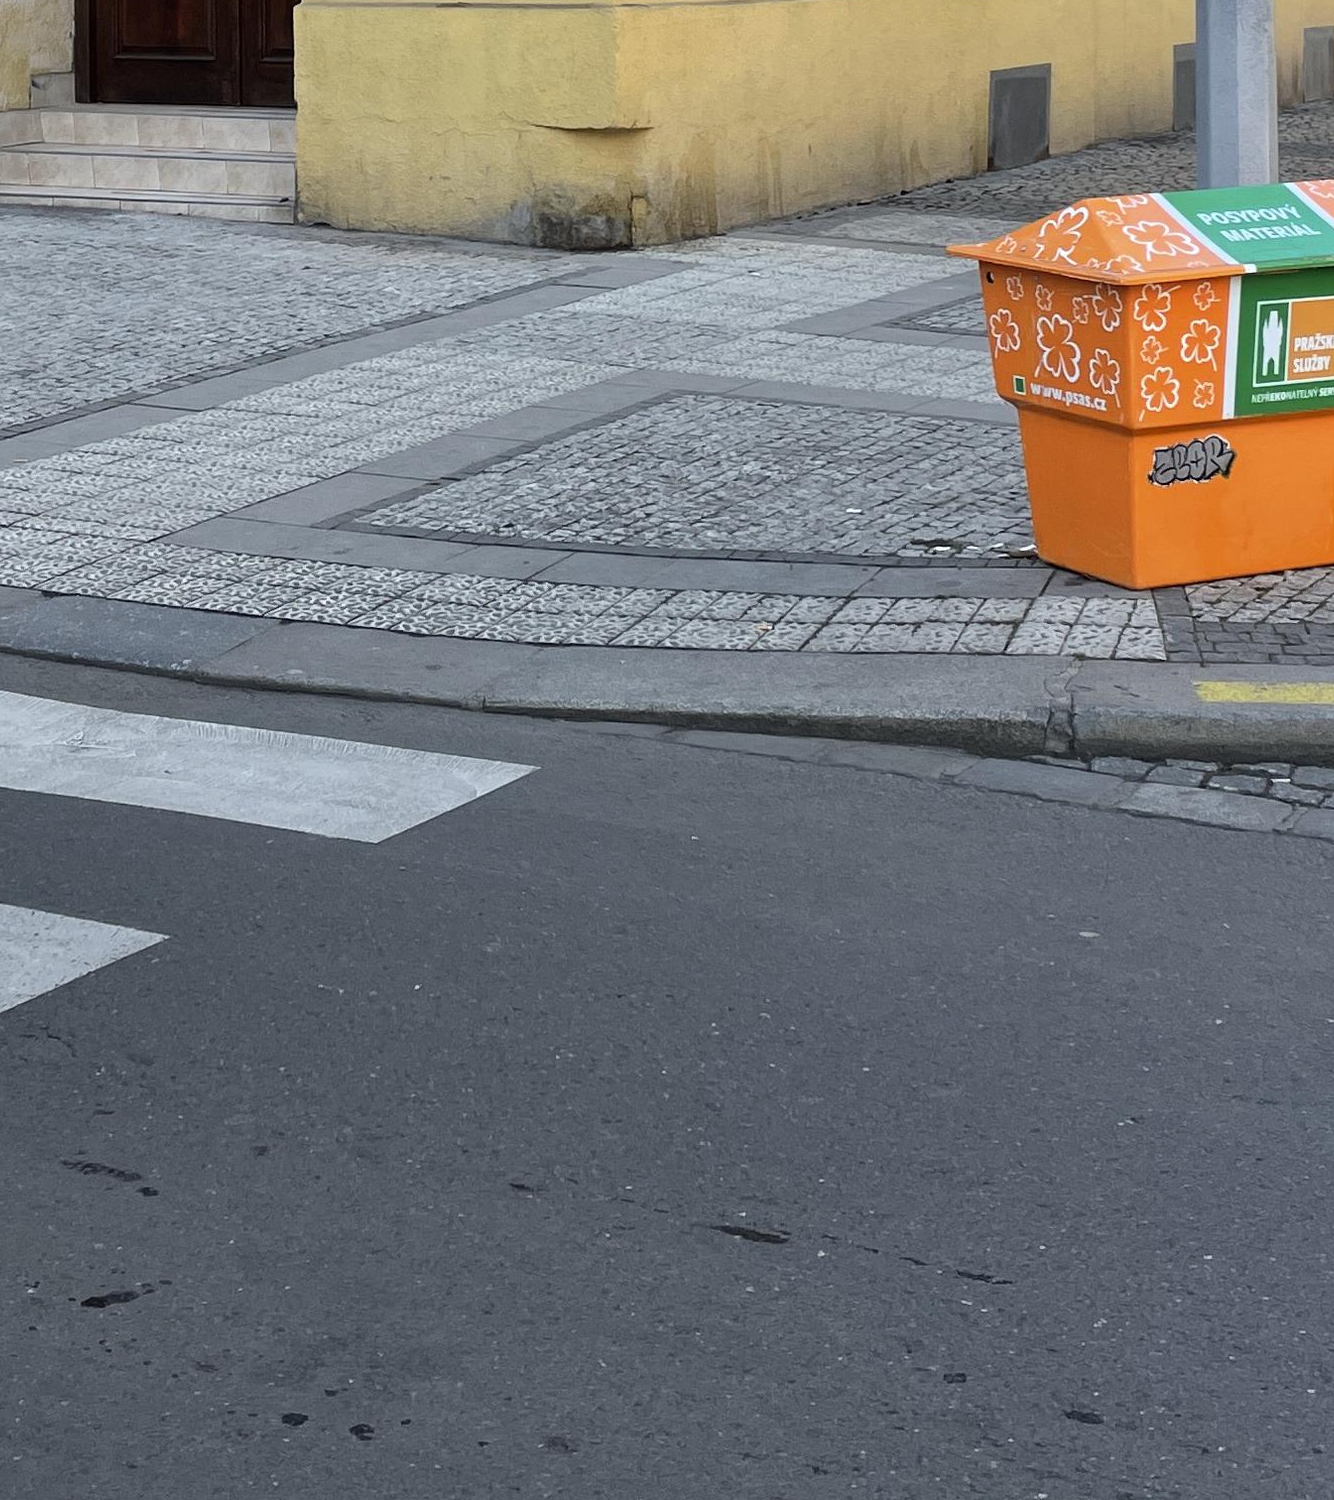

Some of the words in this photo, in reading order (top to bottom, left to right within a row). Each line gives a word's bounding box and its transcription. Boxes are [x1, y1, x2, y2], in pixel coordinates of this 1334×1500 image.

[1196, 203, 1302, 226] POSYPOVÝ
[1219, 221, 1323, 242] MATERIÁL
[1292, 354, 1332, 373] SLUŽBY
[1030, 382, 1107, 411] www.psas.cz
